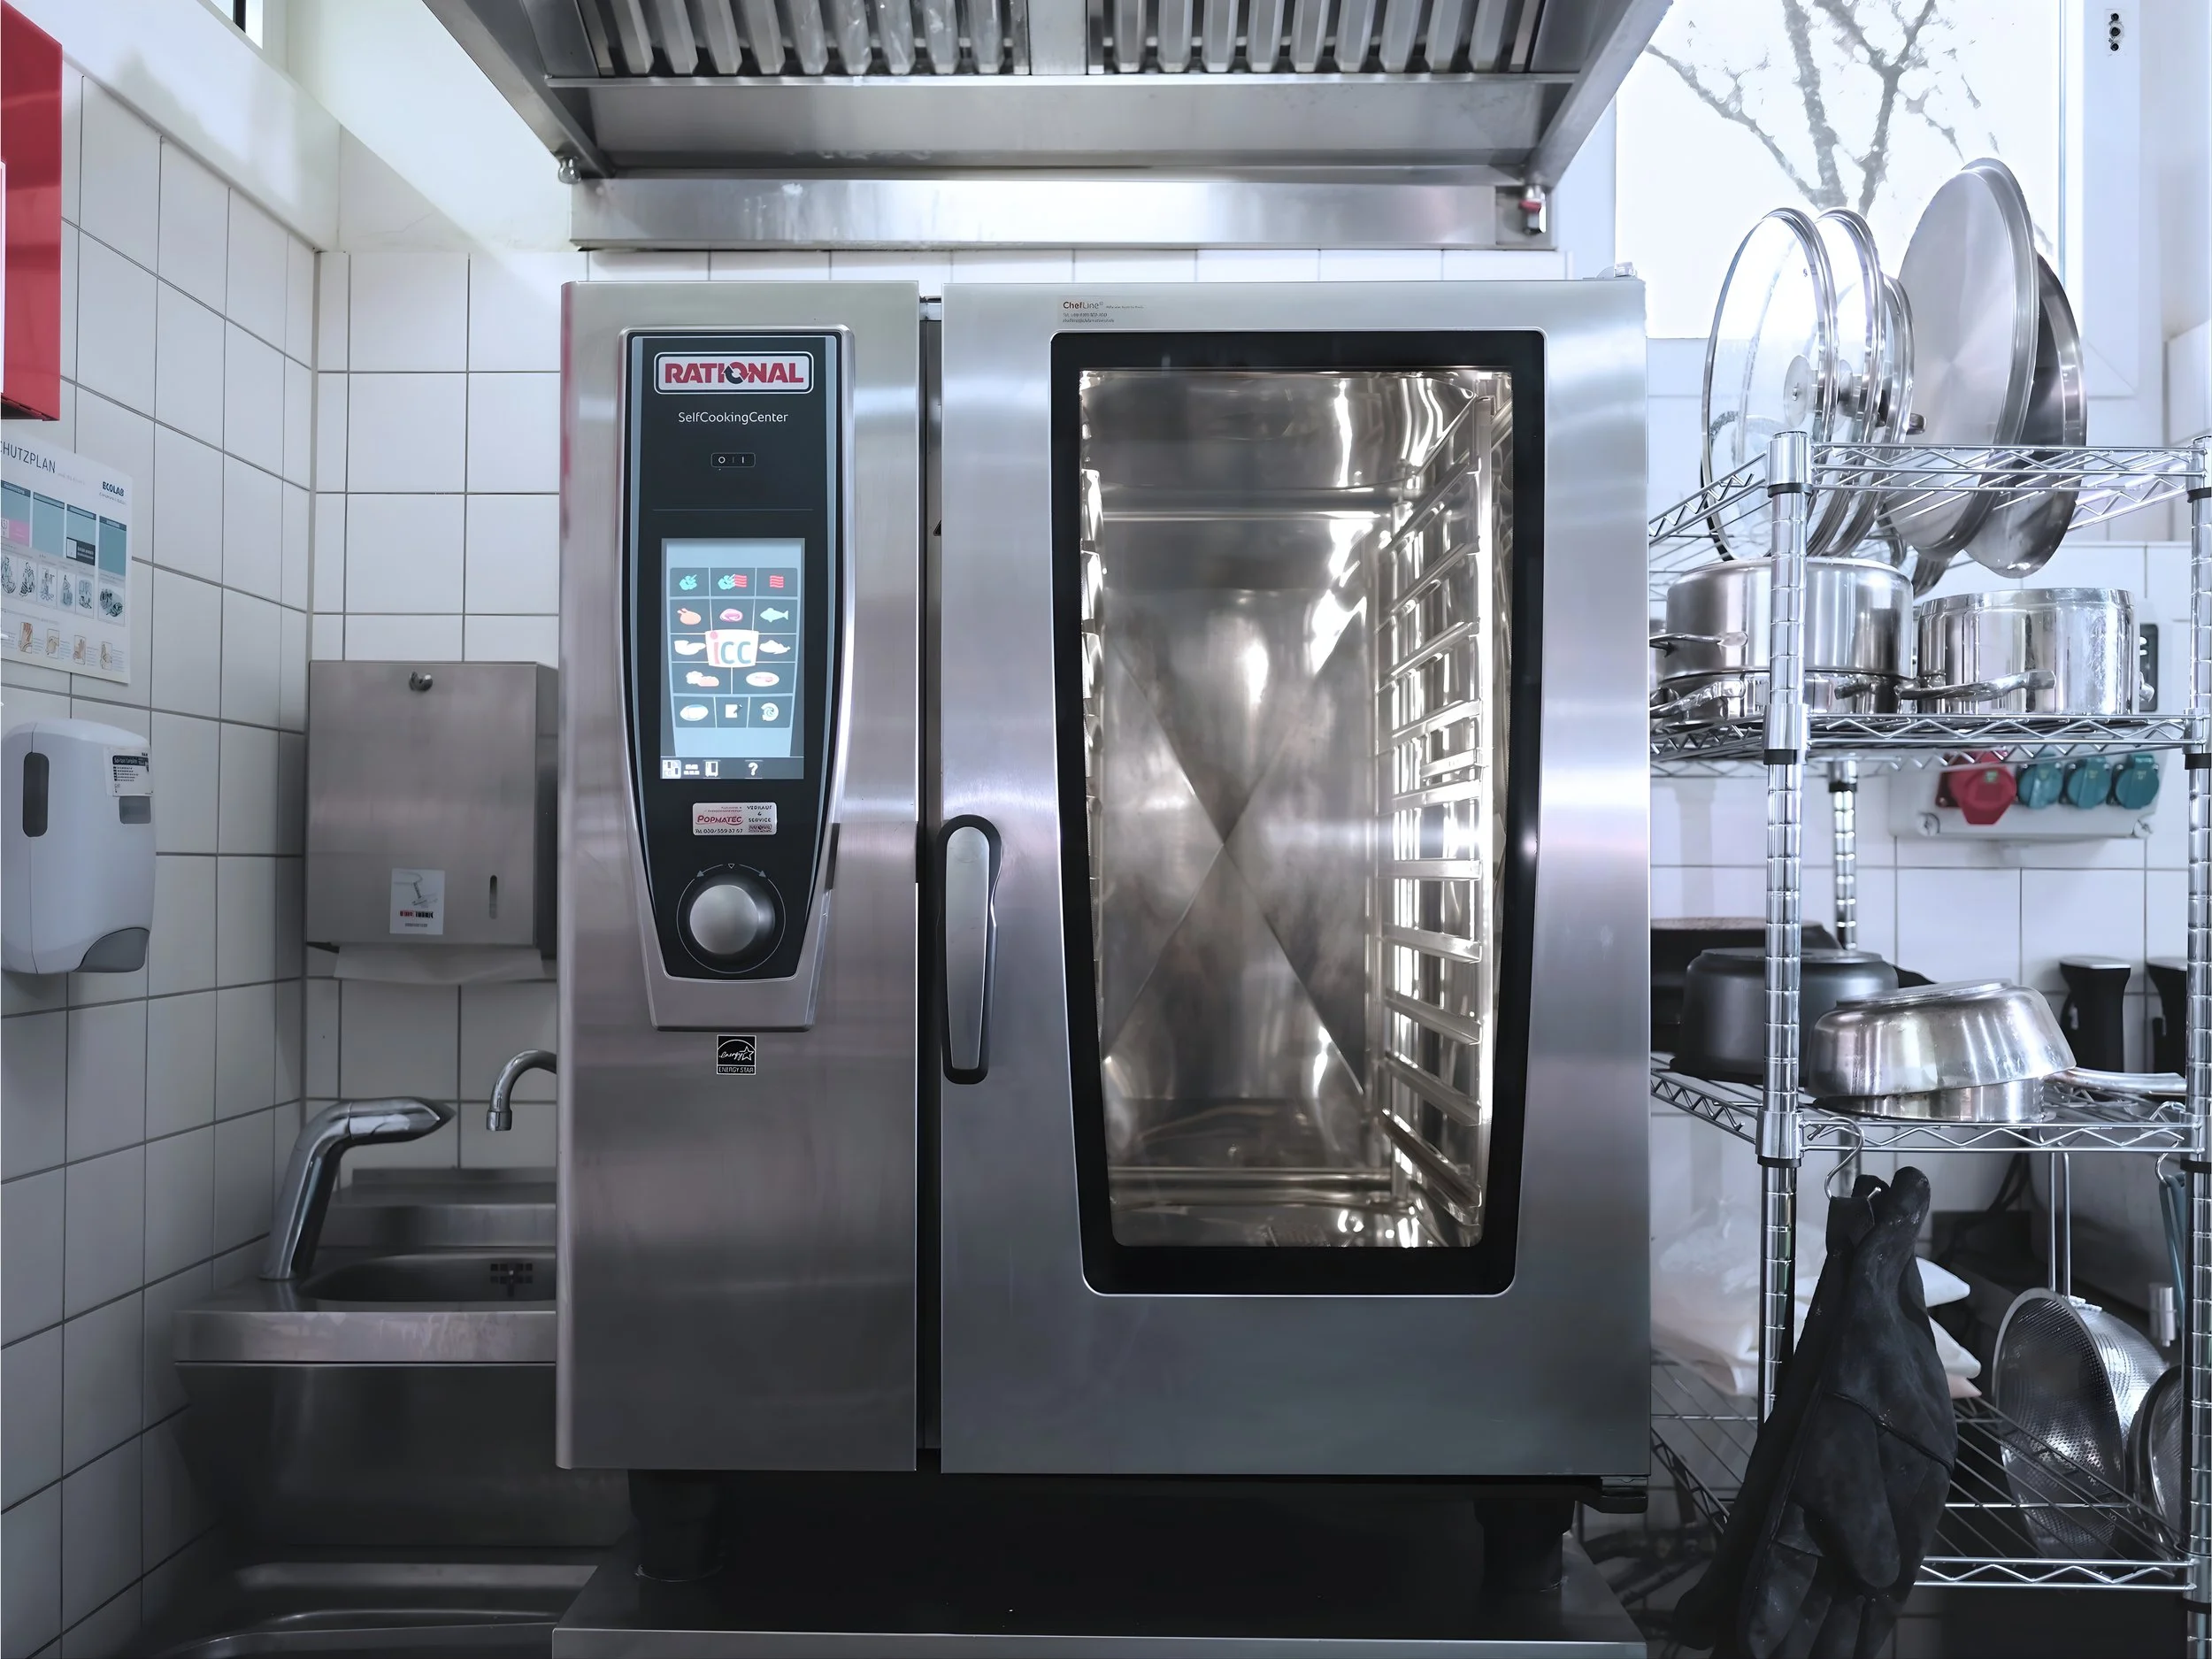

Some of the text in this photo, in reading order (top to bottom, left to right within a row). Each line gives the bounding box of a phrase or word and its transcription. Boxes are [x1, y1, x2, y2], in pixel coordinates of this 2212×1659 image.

[664, 361, 804, 385] RATIONAL
[678, 411, 789, 426] SelfCookingCenter
[1, 441, 56, 473] HUTZPLAN
[102, 480, 125, 497] ECOLAB
[695, 815, 743, 824] POPMATEC
